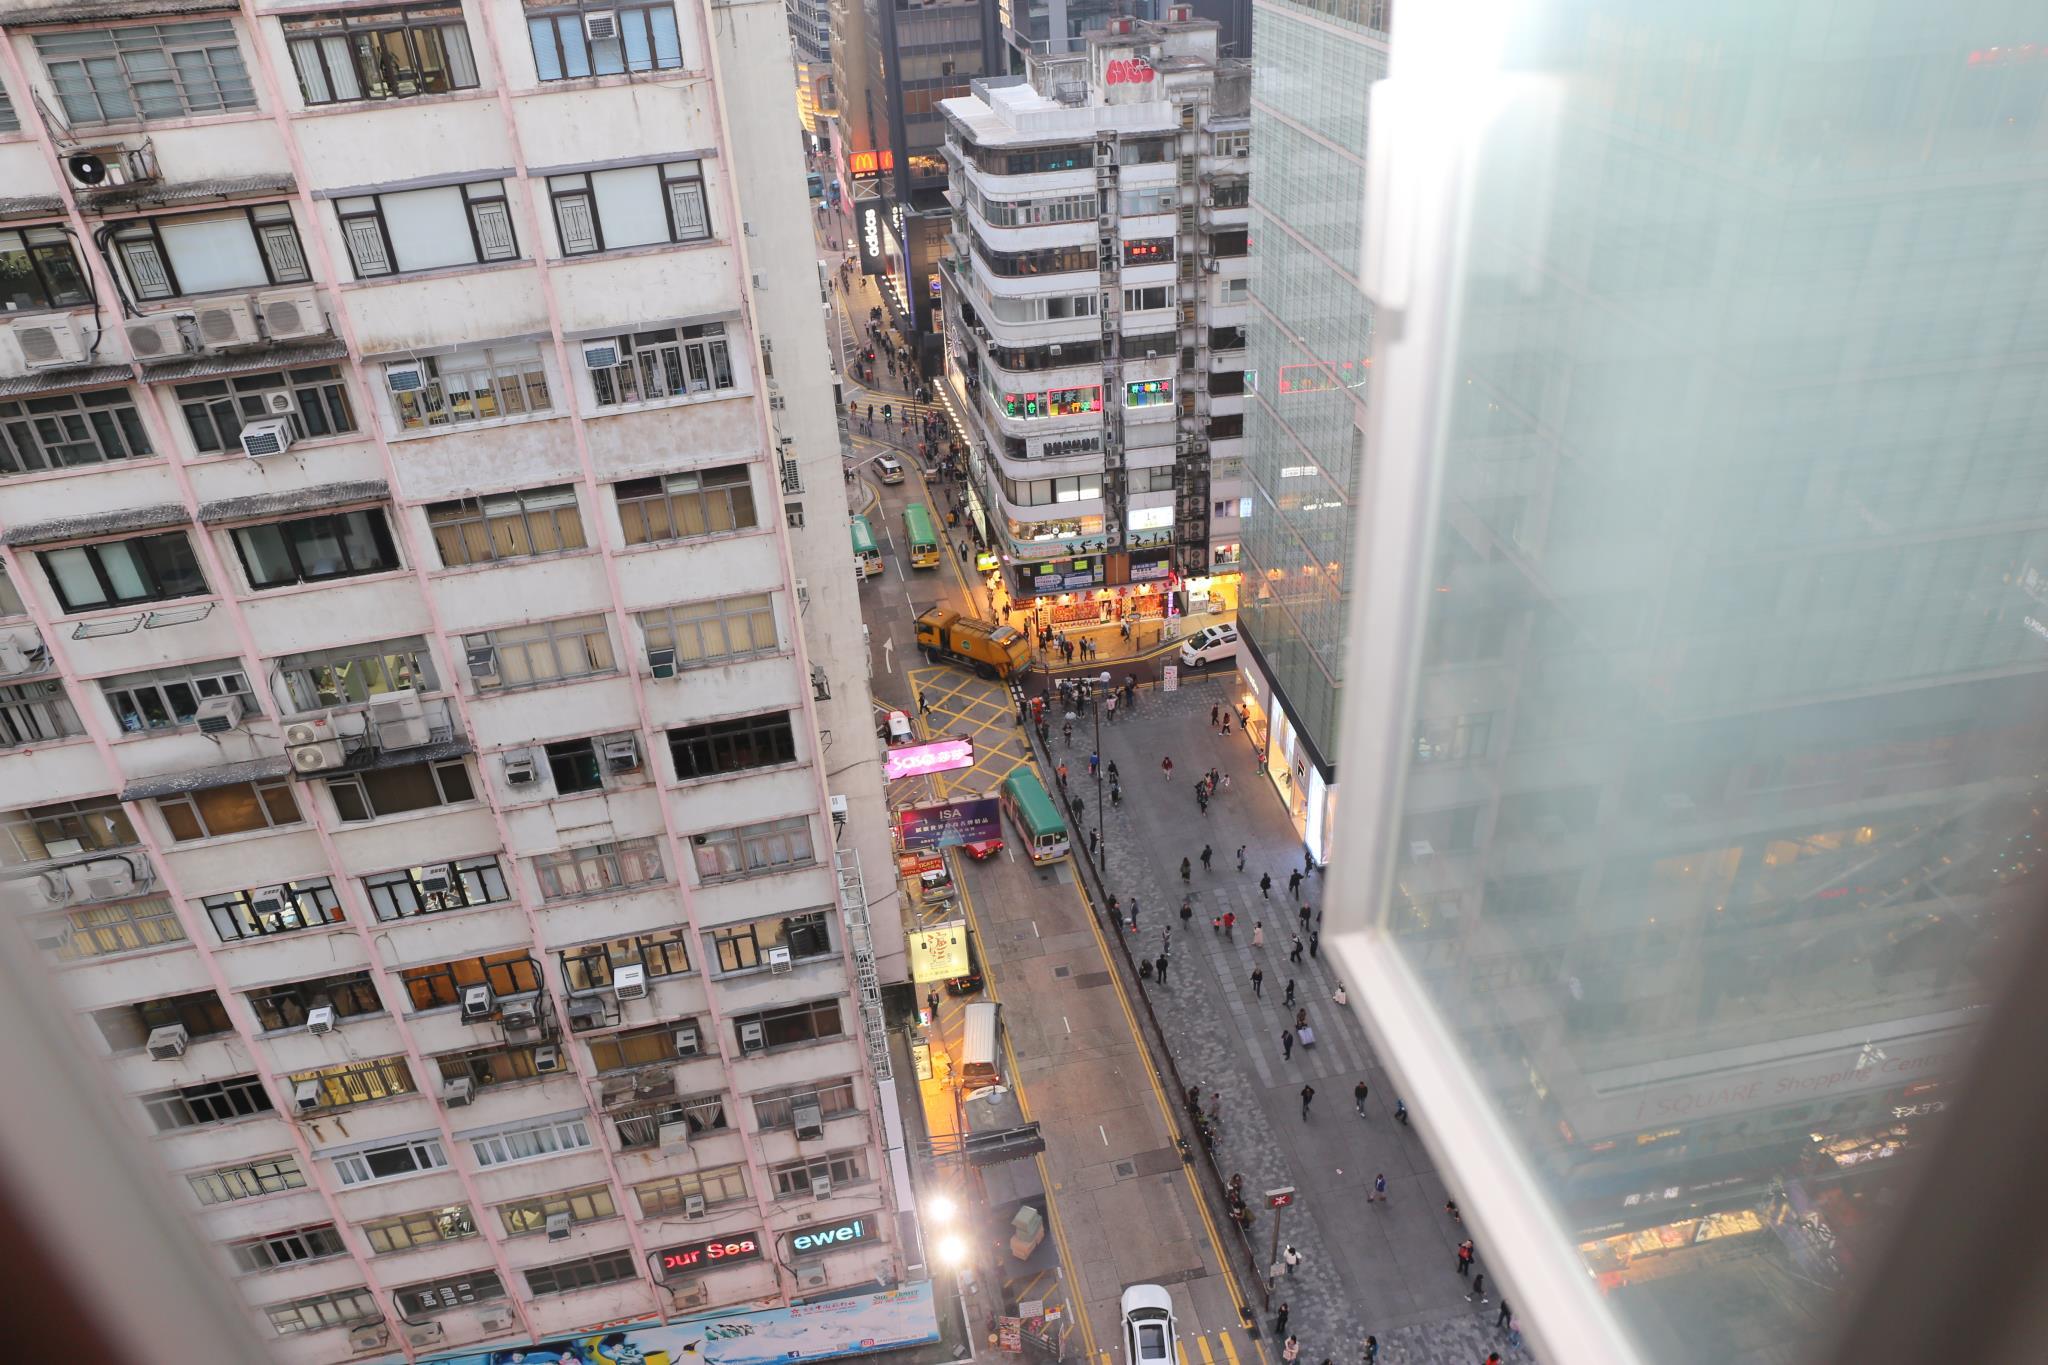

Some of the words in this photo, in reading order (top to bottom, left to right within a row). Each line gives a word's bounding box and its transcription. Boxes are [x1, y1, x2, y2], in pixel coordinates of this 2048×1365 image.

[865, 209, 880, 257] adidas
[939, 808, 962, 819] ISA
[1656, 1081, 1761, 1115] SQUARE
[1775, 1066, 1873, 1093] Shopping
[706, 1240, 755, 1259] Sea
